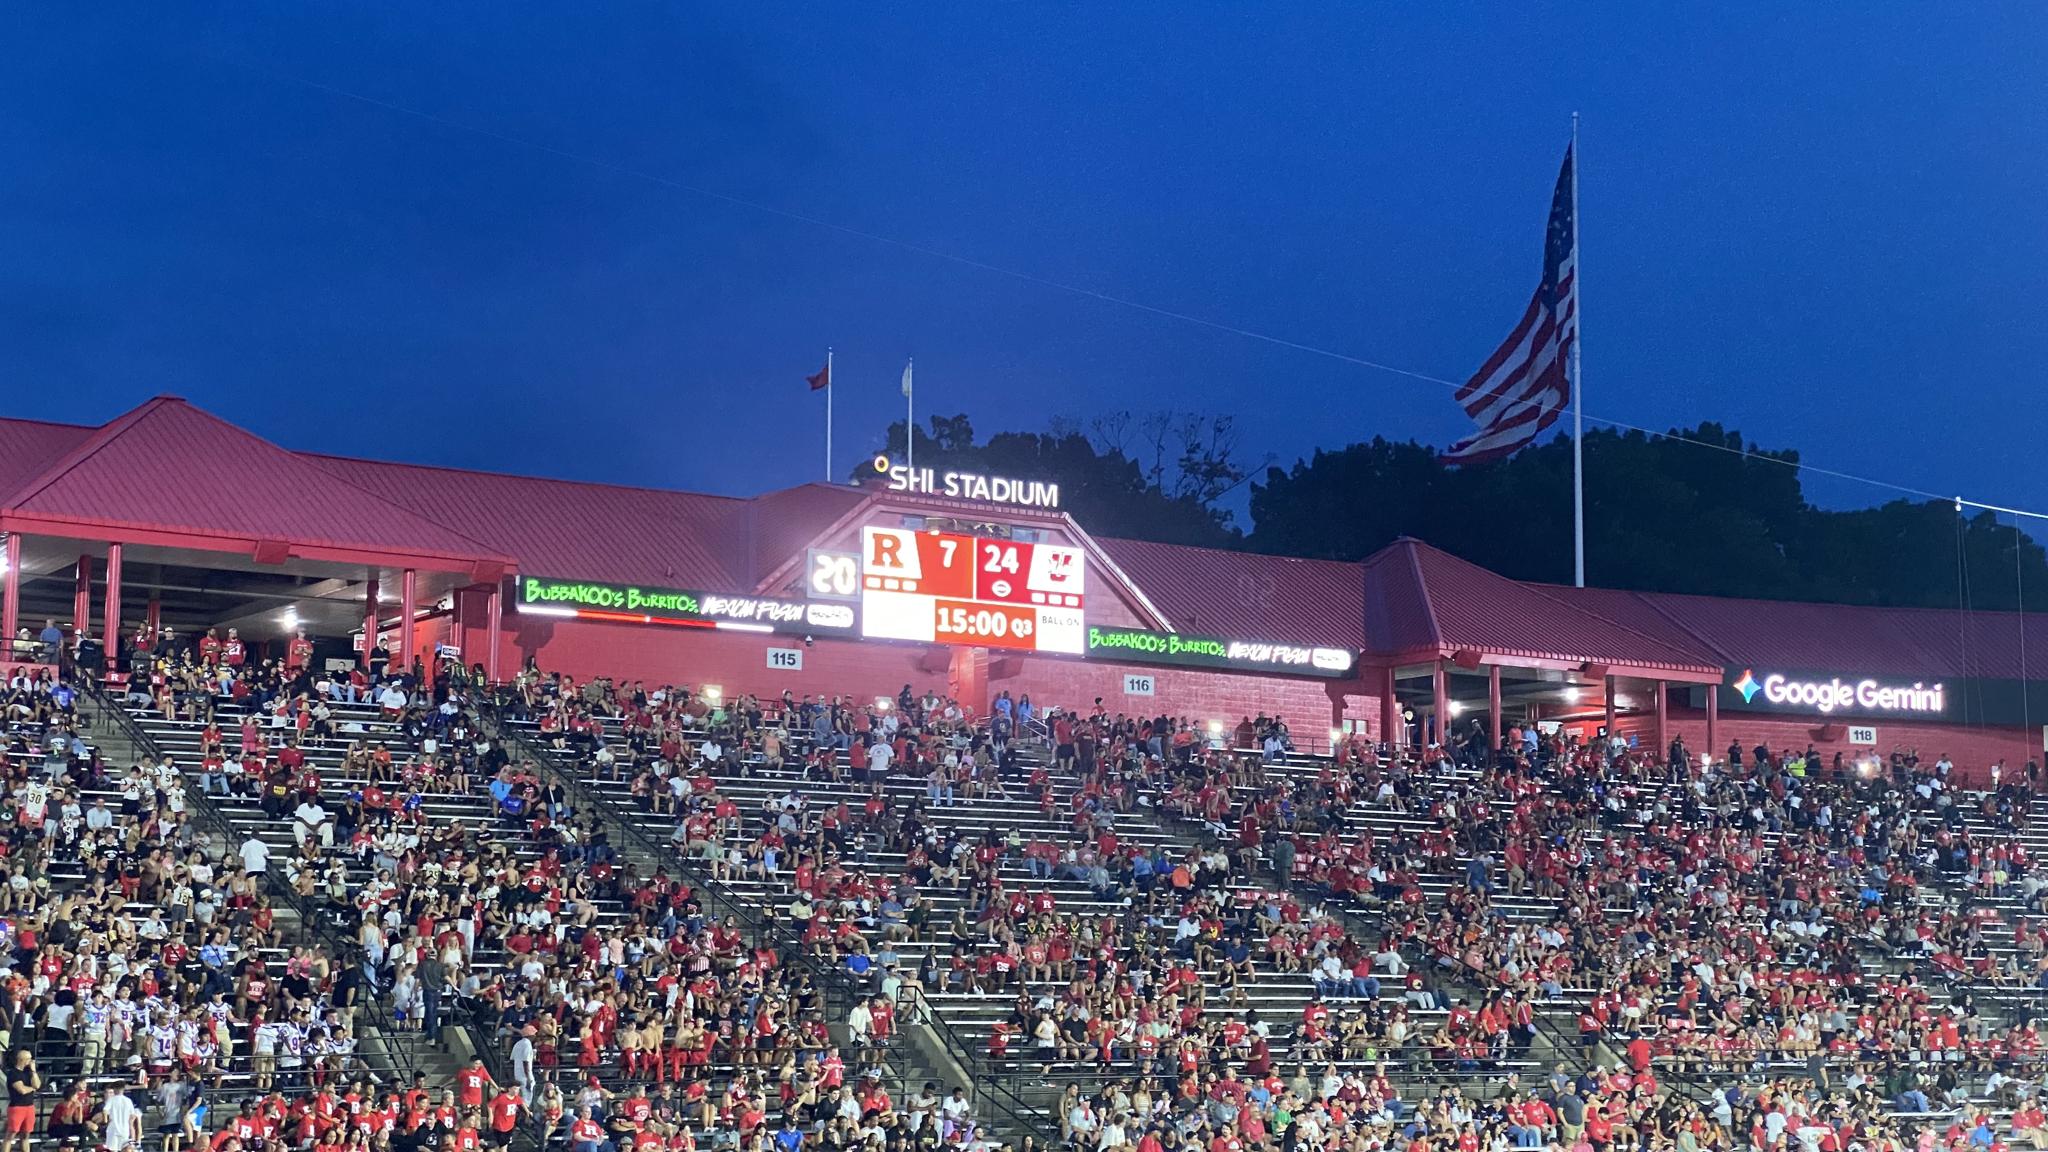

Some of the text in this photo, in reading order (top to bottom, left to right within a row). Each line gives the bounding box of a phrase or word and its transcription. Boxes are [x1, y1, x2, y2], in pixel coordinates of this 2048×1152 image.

[889, 466, 1058, 508] SHI STADIUM
[872, 532, 903, 569] R
[939, 540, 957, 569] 7
[984, 544, 1019, 574] 24
[813, 554, 857, 595] 20
[936, 607, 1033, 638] 15:00 Q3
[772, 652, 796, 666] 115
[1129, 678, 1150, 692] 116
[1764, 674, 1943, 712] Google Gemini
[1853, 730, 1872, 741] 118
[30, 793, 42, 804] 30
[1477, 806, 1484, 814] R
[1014, 903, 1025, 914] R
[1042, 900, 1052, 908] R
[1599, 1000, 1607, 1010] R
[468, 1076, 480, 1088] R
[506, 1104, 516, 1116] R
[384, 1119, 394, 1130] R
[444, 1116, 454, 1128] R
[240, 1124, 252, 1138] R
[584, 1124, 598, 1136] R
[464, 1138, 473, 1149] R
